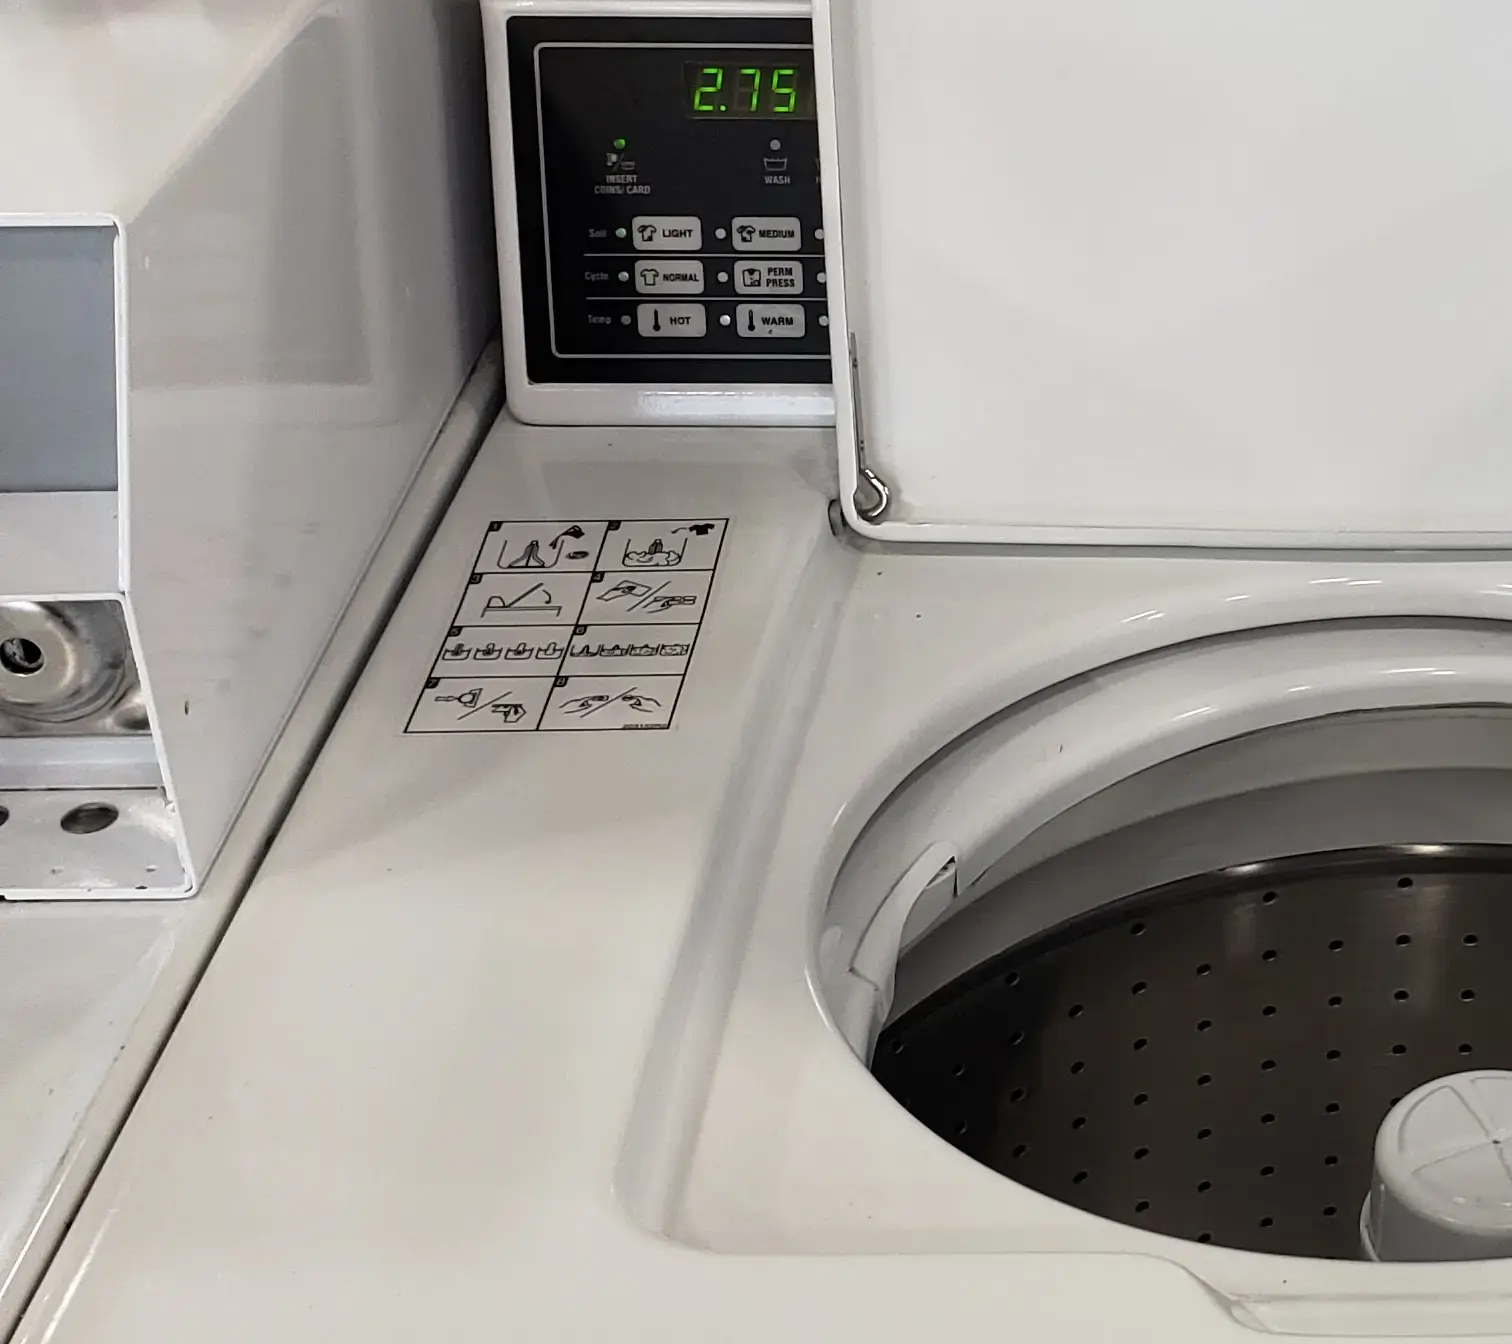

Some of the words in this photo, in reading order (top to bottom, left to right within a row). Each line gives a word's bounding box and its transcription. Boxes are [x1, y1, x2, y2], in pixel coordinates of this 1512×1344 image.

[692, 67, 798, 113] 2.75
[606, 173, 638, 184] INSERT
[763, 174, 791, 185] WASH
[626, 184, 651, 195] CARD
[588, 229, 607, 239] Soil
[661, 228, 694, 240] LIGHT
[758, 229, 795, 240] MEDIUM
[584, 271, 609, 282] Cycle
[662, 272, 700, 283] NORMAL
[766, 267, 793, 277] PERM
[765, 278, 796, 289] PRESS
[669, 316, 692, 326] HOT
[761, 316, 794, 326] WARM
